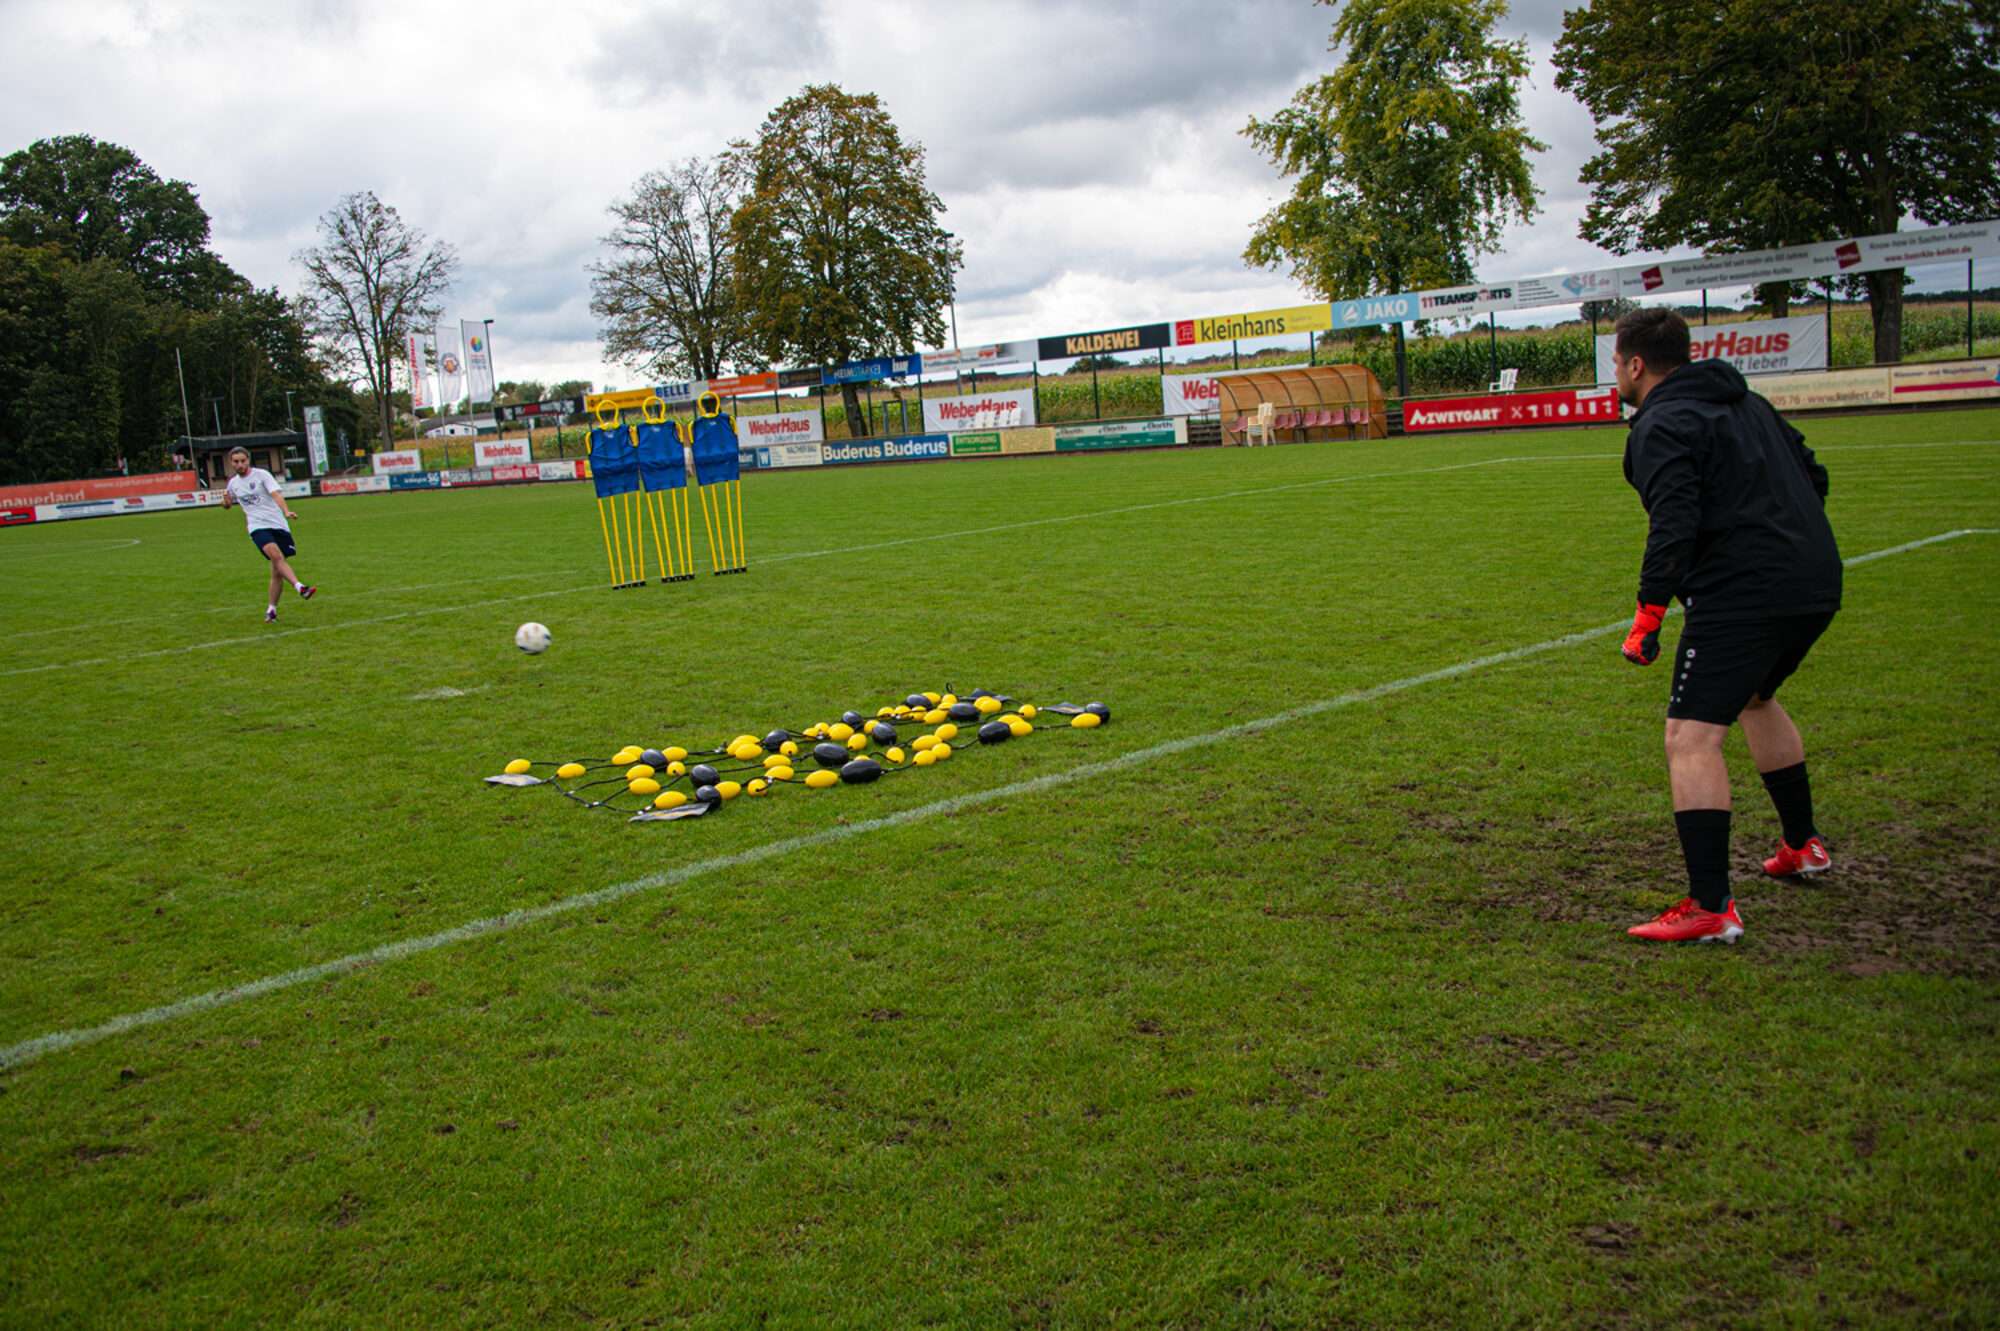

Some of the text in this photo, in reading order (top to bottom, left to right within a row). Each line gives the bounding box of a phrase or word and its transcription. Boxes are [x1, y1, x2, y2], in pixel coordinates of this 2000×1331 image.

[1365, 299, 1408, 321] JAKO
[1201, 315, 1285, 342] kleinhans
[1066, 329, 1140, 355] KALDEWEI
[1688, 331, 1791, 360] erHaus
[1747, 356, 1788, 370] leben
[749, 418, 810, 435] WeberHaus
[823, 445, 881, 461] Buderus
[883, 440, 947, 457] Buderus
